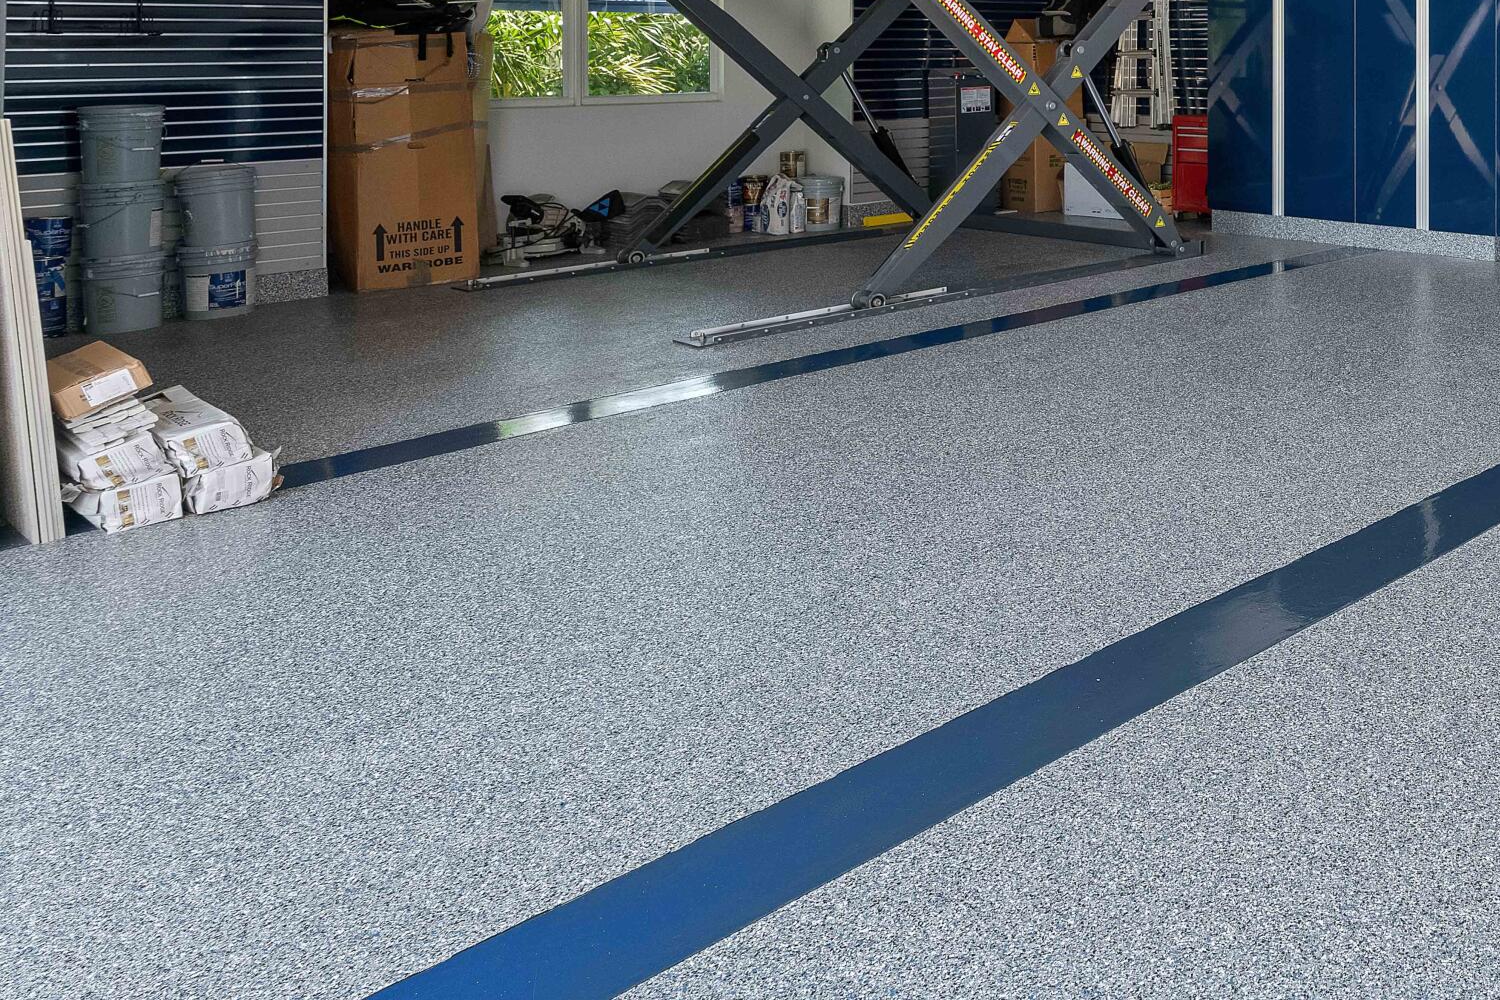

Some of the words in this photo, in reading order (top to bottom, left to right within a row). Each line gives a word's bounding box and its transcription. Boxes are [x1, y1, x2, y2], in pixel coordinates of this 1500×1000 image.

[978, 31, 999, 53] STAY
[997, 51, 1023, 79] CLEAR
[1080, 138, 1110, 171] WARNING
[1112, 173, 1130, 191] STAY
[1128, 189, 1149, 213] CLEAR
[397, 218, 441, 233] HANDLE
[386, 233, 417, 245] WITH
[421, 228, 452, 242] CARE
[389, 249, 410, 259] THIS
[413, 246, 435, 257] SIDE
[437, 244, 450, 254] UP
[377, 255, 464, 274] WARROBE
